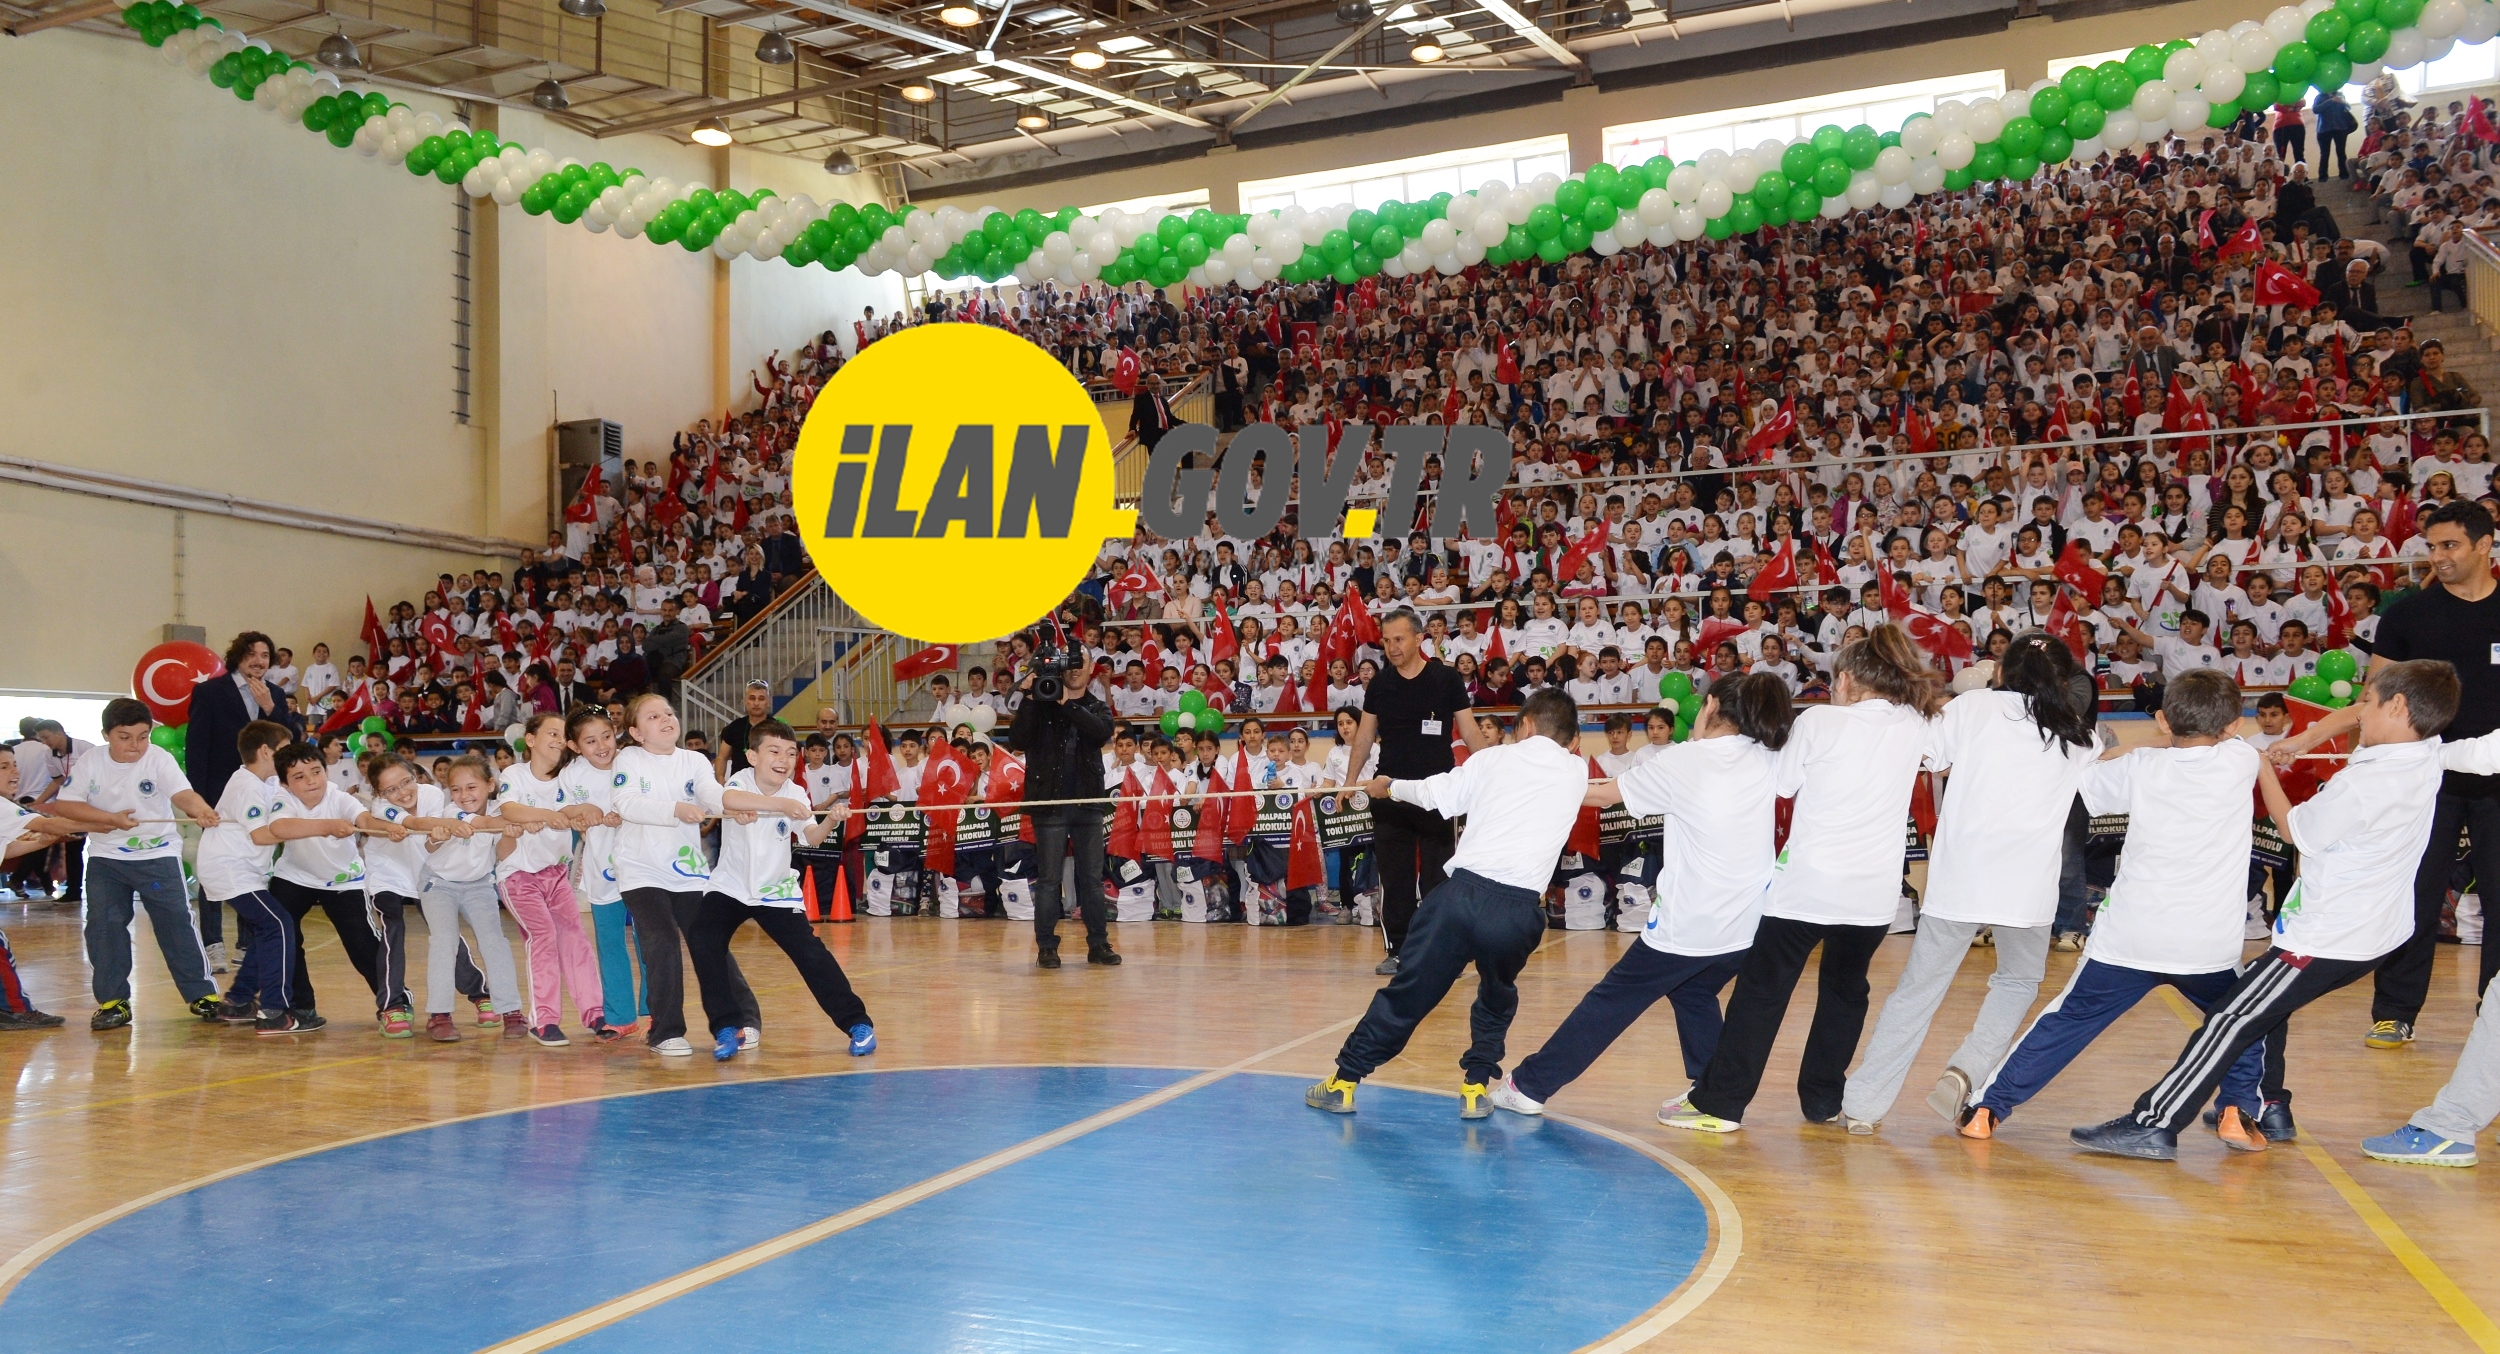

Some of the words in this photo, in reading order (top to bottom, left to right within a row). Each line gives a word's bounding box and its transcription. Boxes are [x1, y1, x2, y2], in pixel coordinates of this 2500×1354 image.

[1326, 826, 1344, 837] TOKİ
[1345, 821, 1365, 834] FATİH
[1600, 818, 1637, 832] YALINTAŞ
